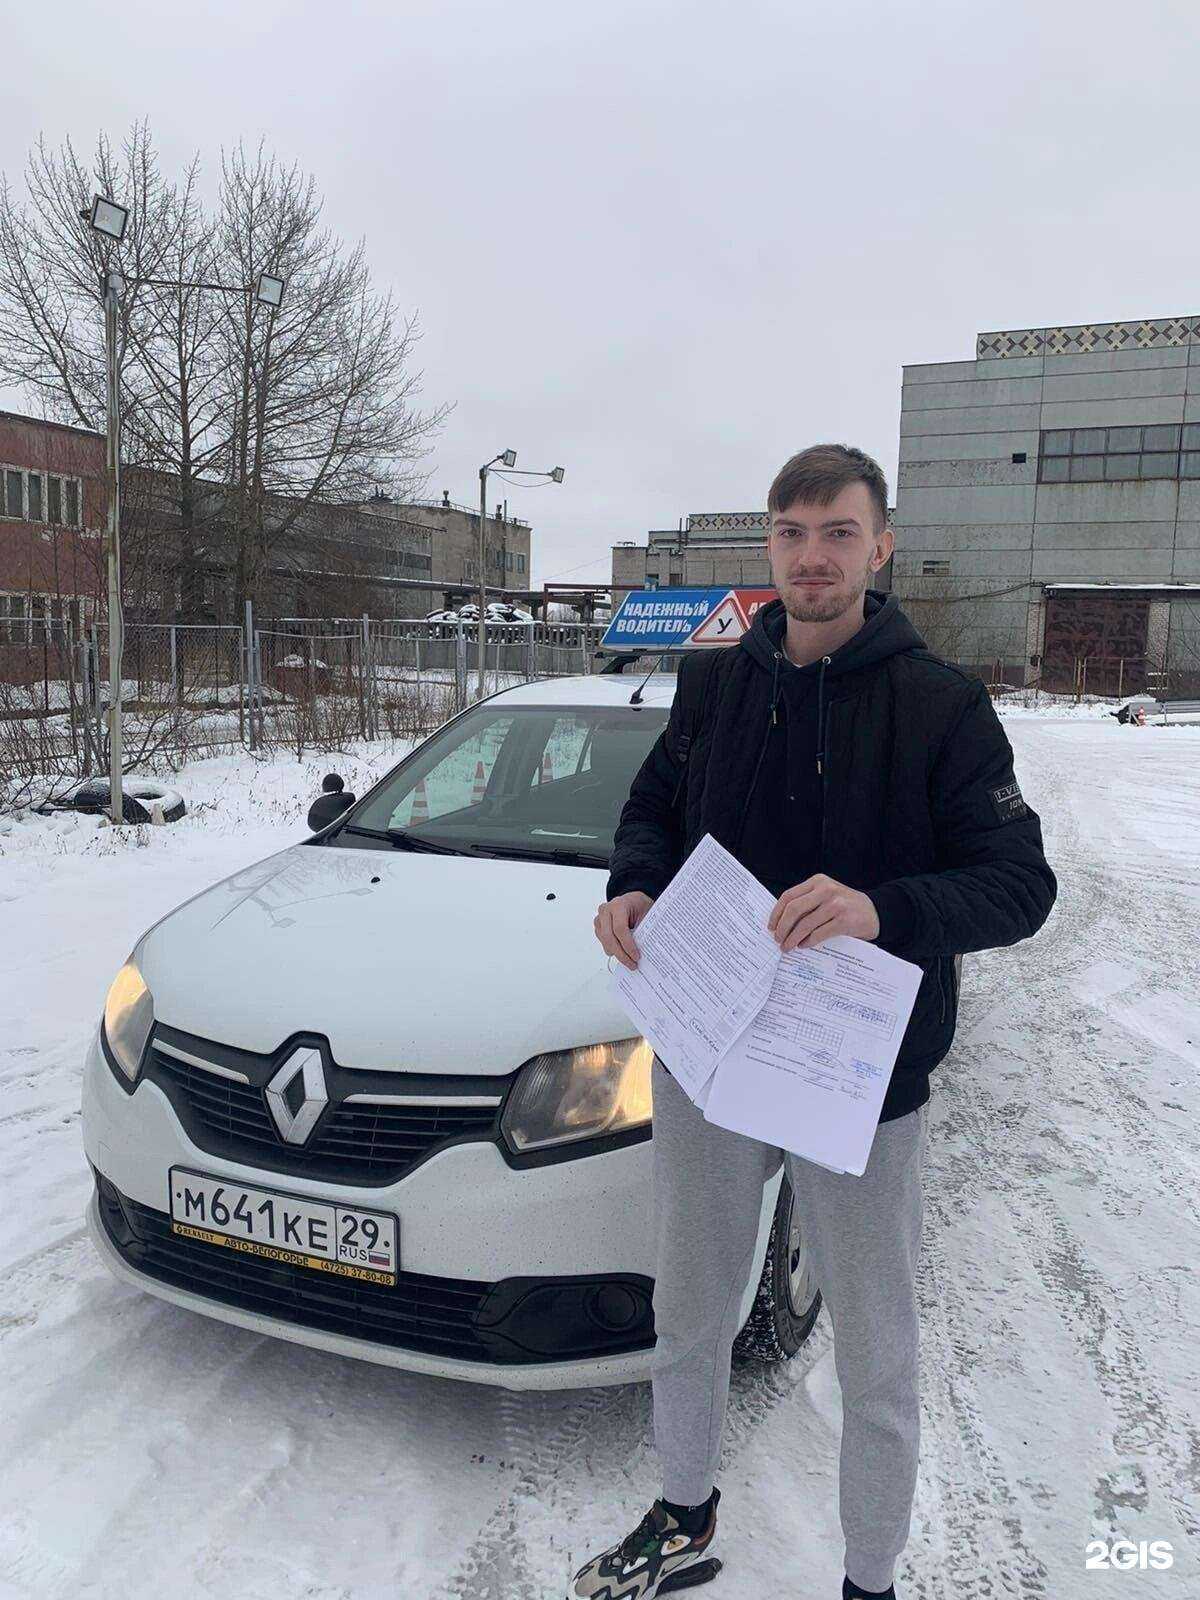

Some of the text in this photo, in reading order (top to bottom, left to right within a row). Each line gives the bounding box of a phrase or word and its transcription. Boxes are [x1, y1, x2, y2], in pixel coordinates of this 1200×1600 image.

[623, 600, 710, 618] НАДЕЖНЫЙ
[616, 619, 693, 634] ВОДИТЕЛЬ
[341, 1214, 379, 1250] 29
[339, 1245, 368, 1260] RUS
